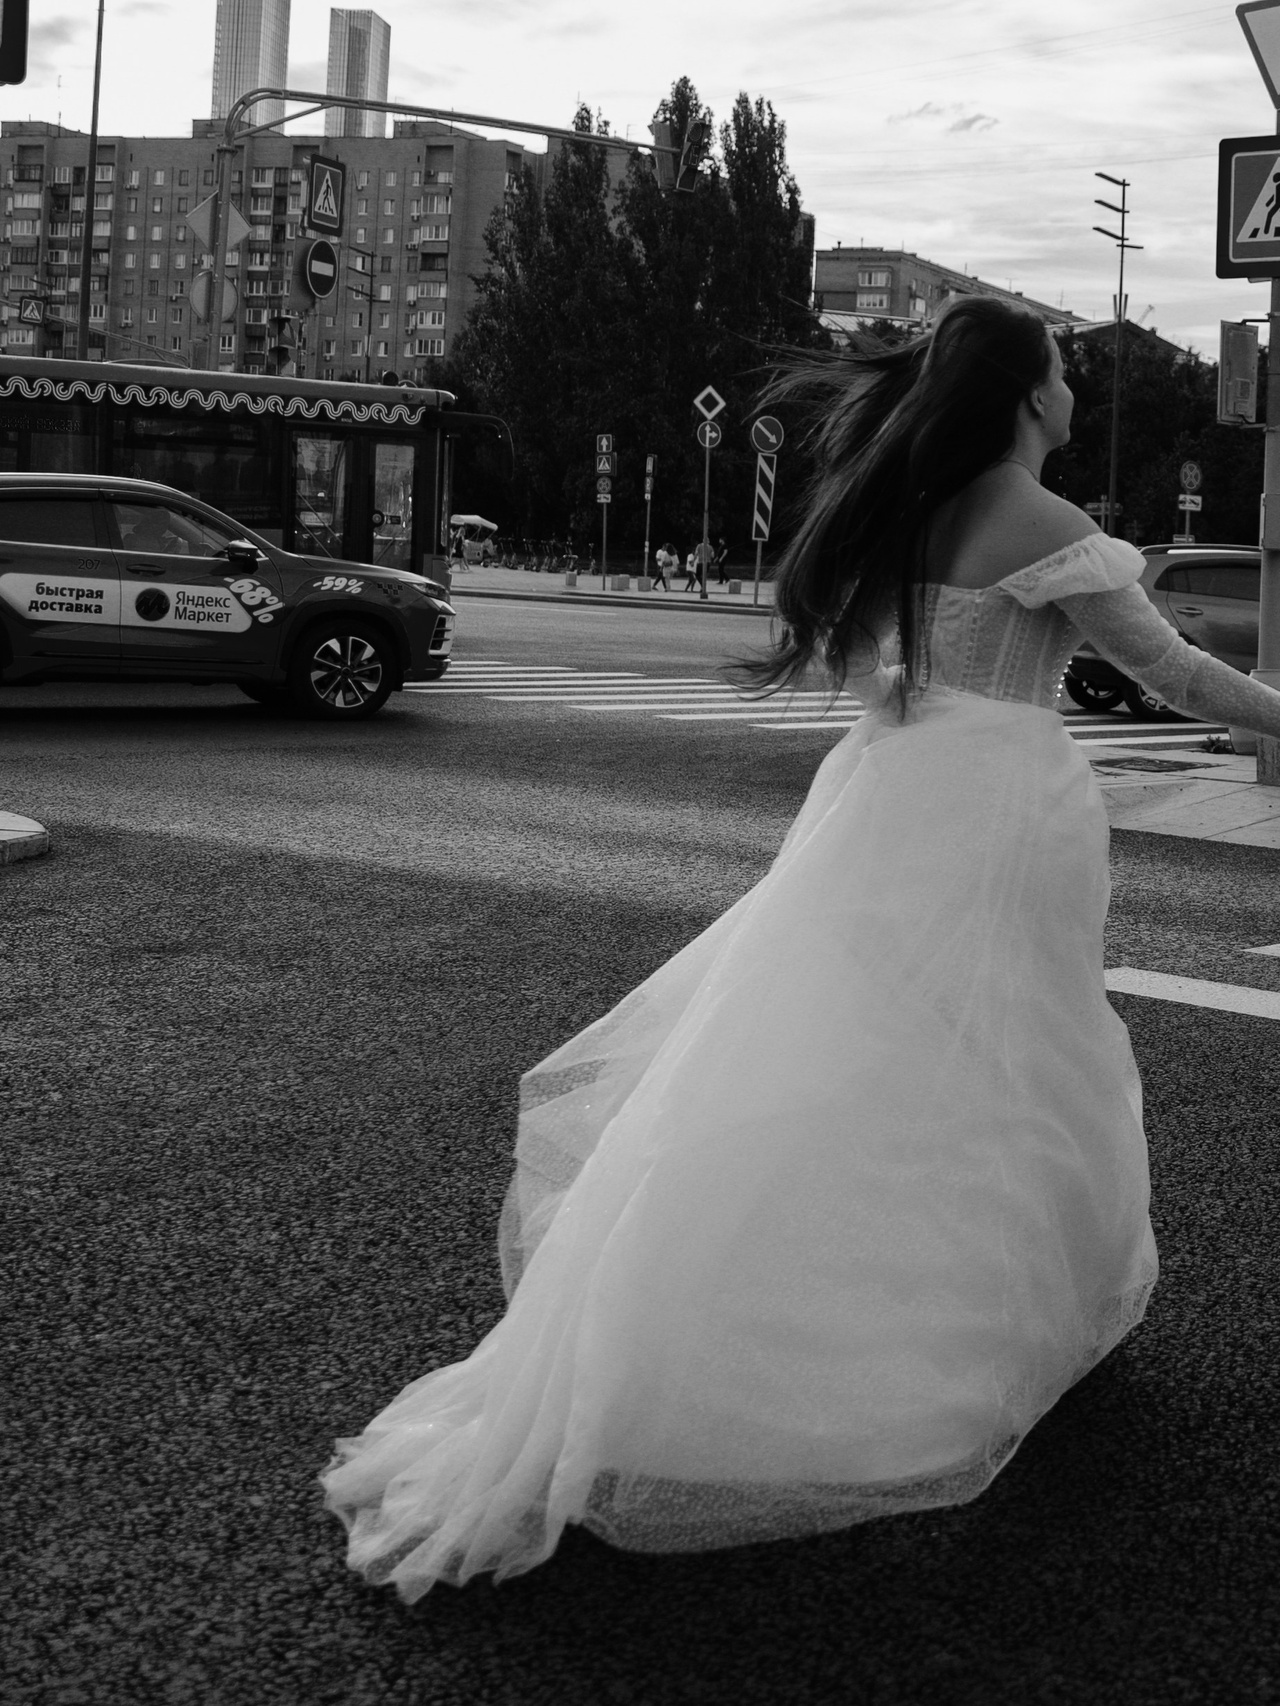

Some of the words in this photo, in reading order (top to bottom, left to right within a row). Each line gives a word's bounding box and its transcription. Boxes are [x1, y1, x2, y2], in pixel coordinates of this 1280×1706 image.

[78, 558, 101, 571] 207
[35, 582, 104, 600] быстрая
[312, 576, 364, 594] -59%
[28, 599, 104, 615] доставка
[175, 590, 231, 609] Яндекс
[223, 577, 285, 624] -68%
[174, 606, 232, 624] Маркет
